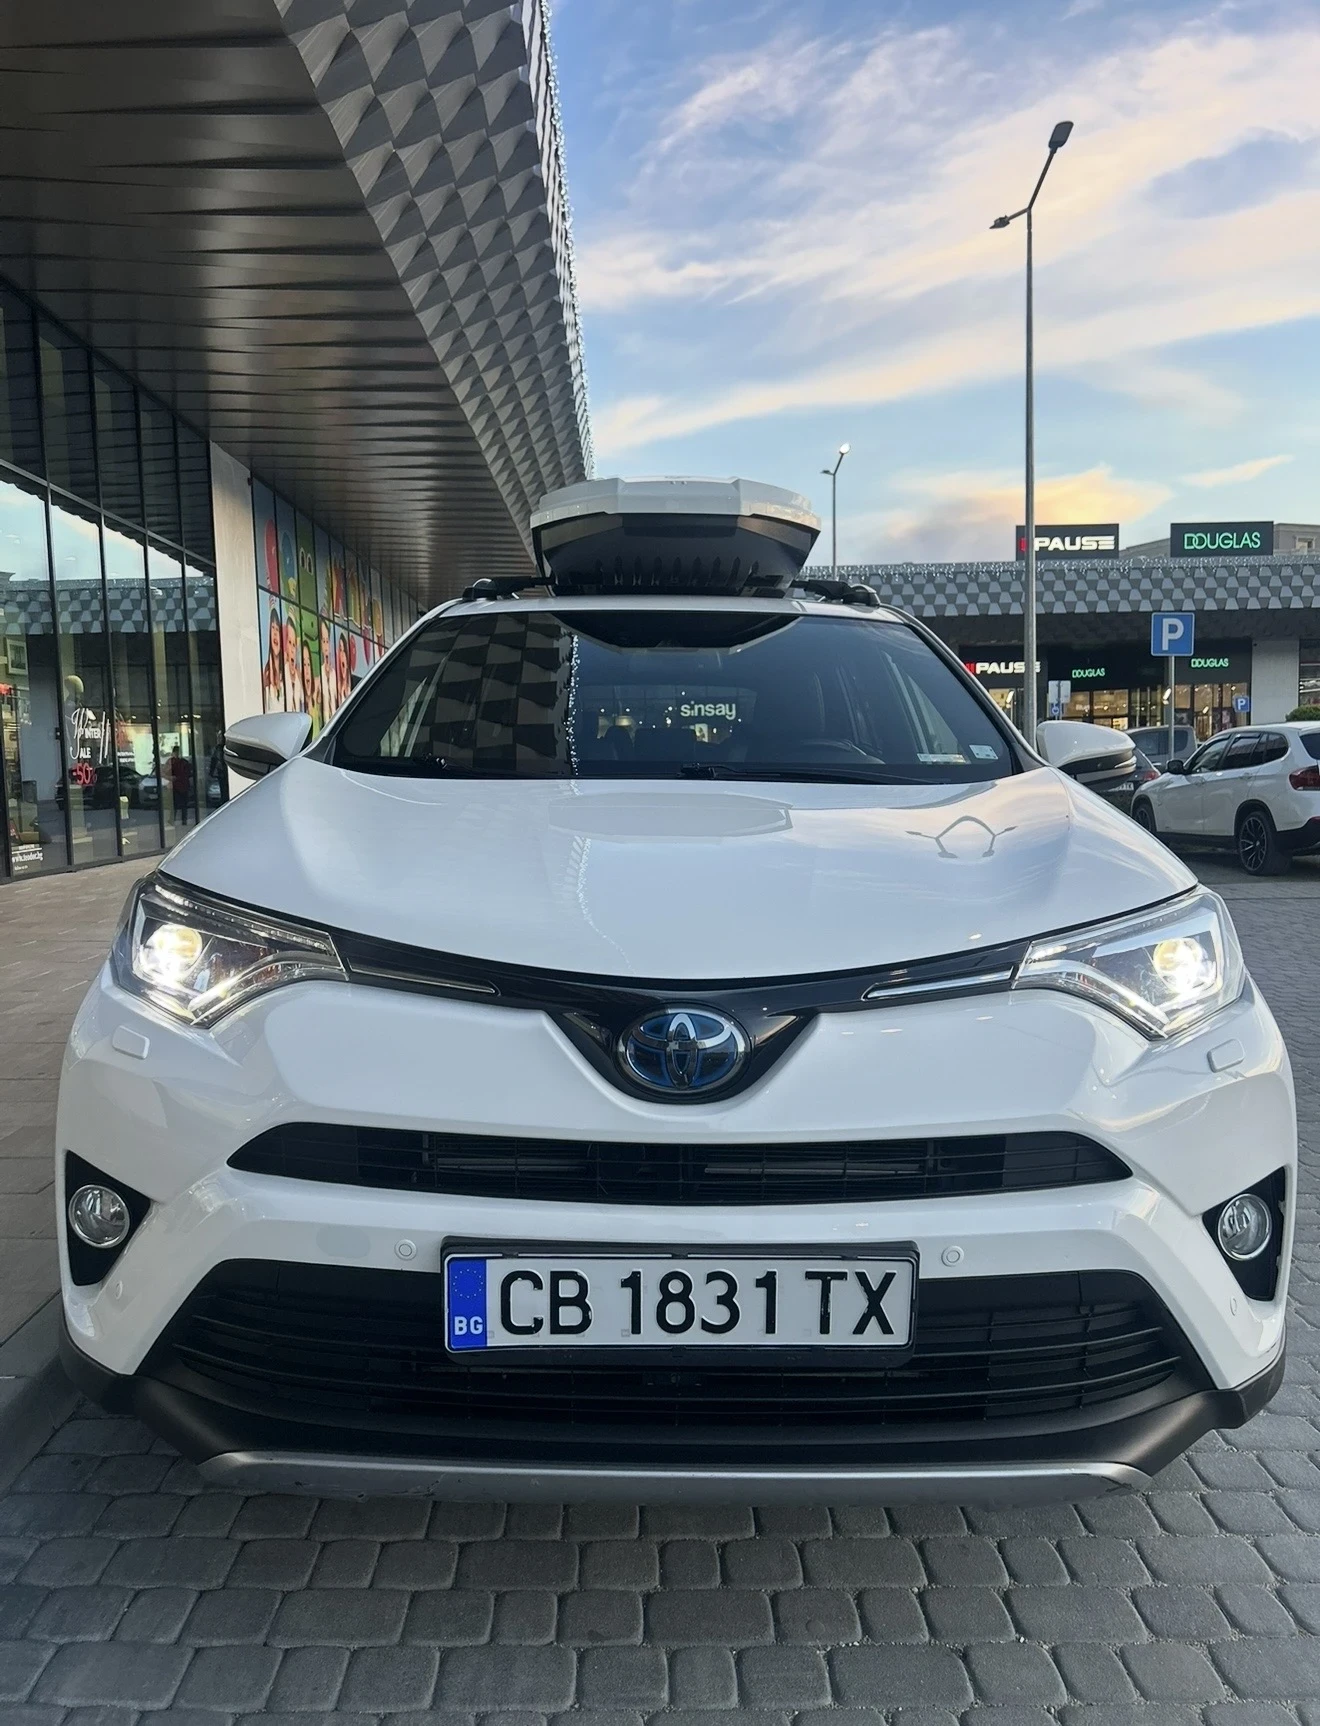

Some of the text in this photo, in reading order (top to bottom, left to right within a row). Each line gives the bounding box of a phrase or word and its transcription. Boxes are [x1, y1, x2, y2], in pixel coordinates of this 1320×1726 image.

[1034, 535, 1115, 551] PAUSE
[1183, 531, 1261, 550] DOUGLAS
[1162, 618, 1184, 651] P
[1191, 658, 1229, 668] DOUGLAS
[1072, 668, 1106, 679] DOUGLAS
[680, 703, 736, 720] sinsay
[1237, 698, 1246, 711] P
[500, 1270, 898, 1335] CB 1831 TX
[454, 1315, 483, 1335] BG
